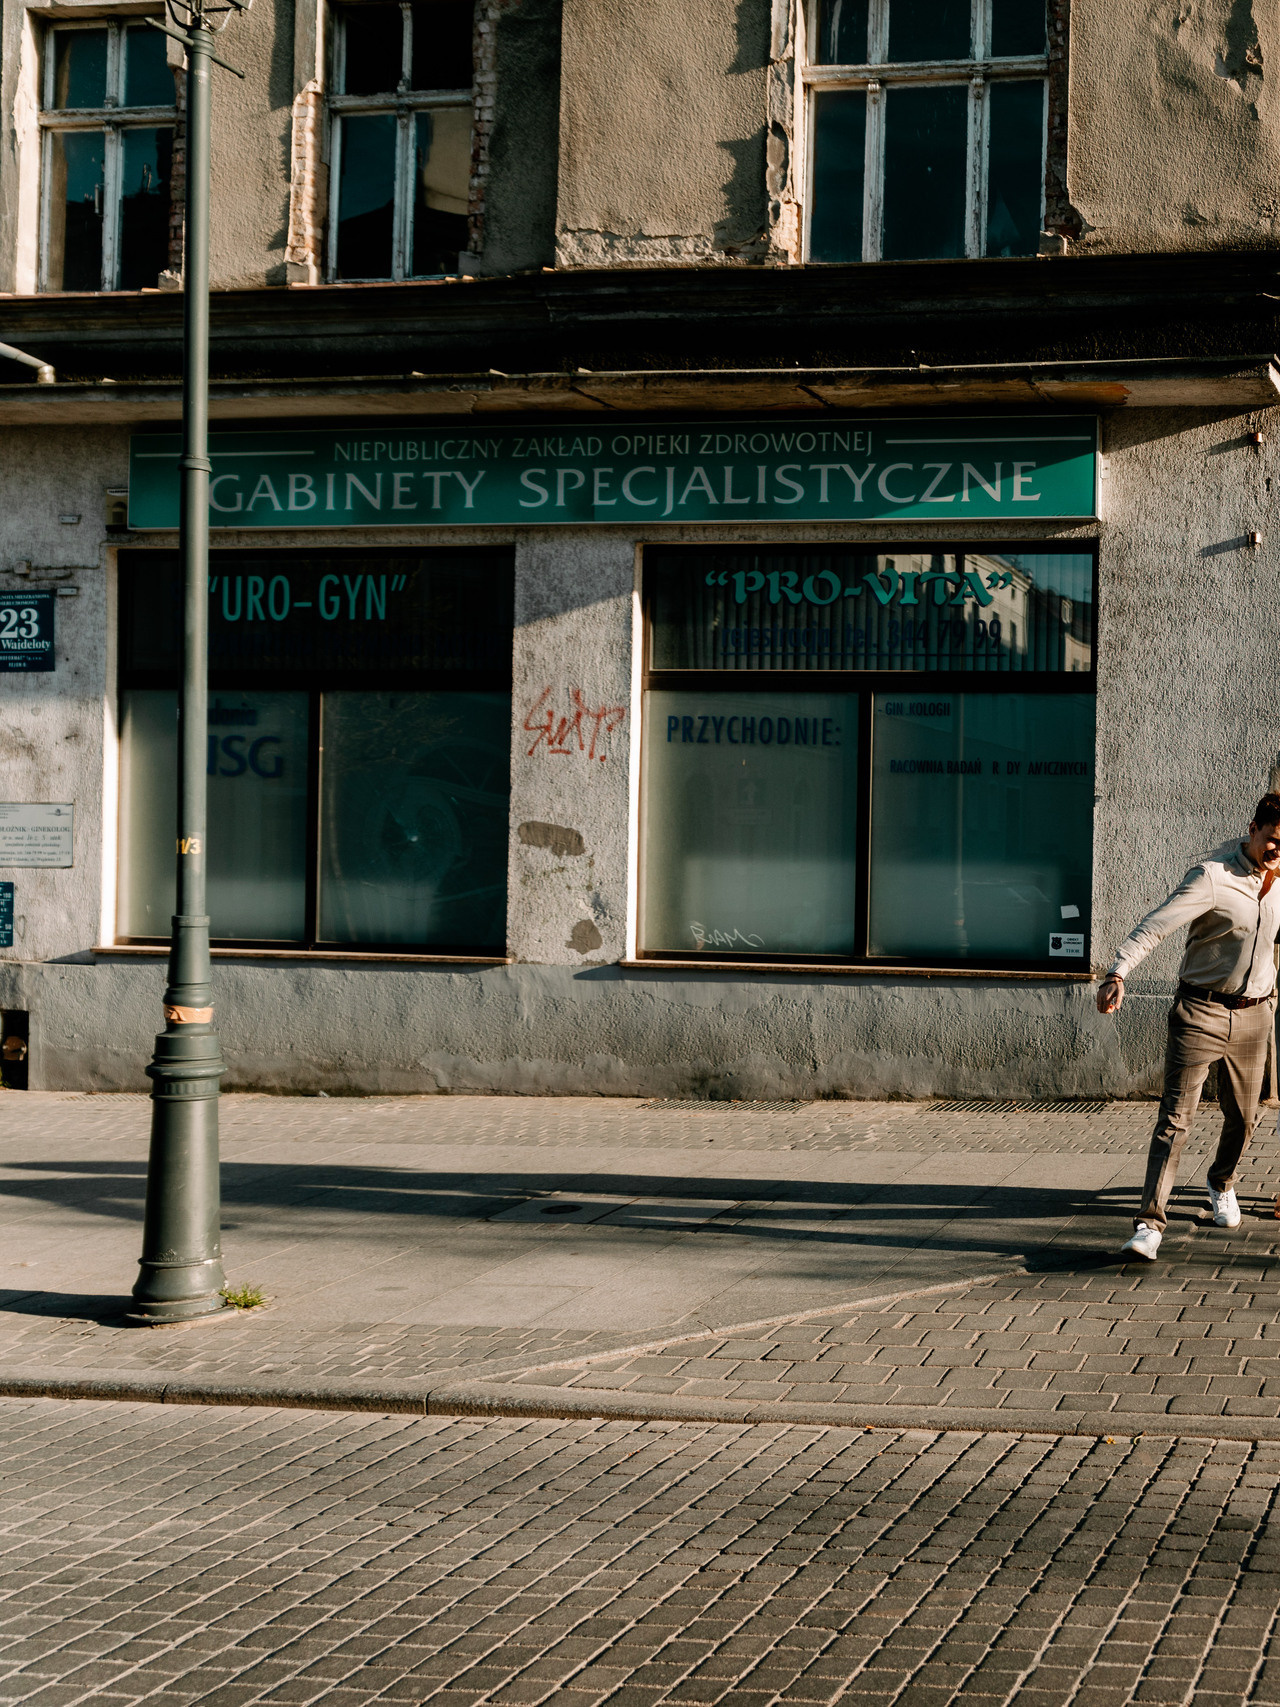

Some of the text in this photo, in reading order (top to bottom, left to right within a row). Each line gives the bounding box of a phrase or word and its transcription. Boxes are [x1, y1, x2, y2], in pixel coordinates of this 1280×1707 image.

[334, 431, 872, 462] NIEPUBLICZNY ZAKŁAD OPIEKI ZDROWOTNEJ
[208, 461, 1042, 517] GABINETY SPECJALISTYCZNE
[0, 608, 39, 639] 23
[887, 619, 929, 649] 344
[936, 619, 966, 649] 79
[974, 619, 1002, 649] 99
[885, 702, 951, 717] GINKOLOGII
[666, 715, 842, 747] PRZYCHODNIE:
